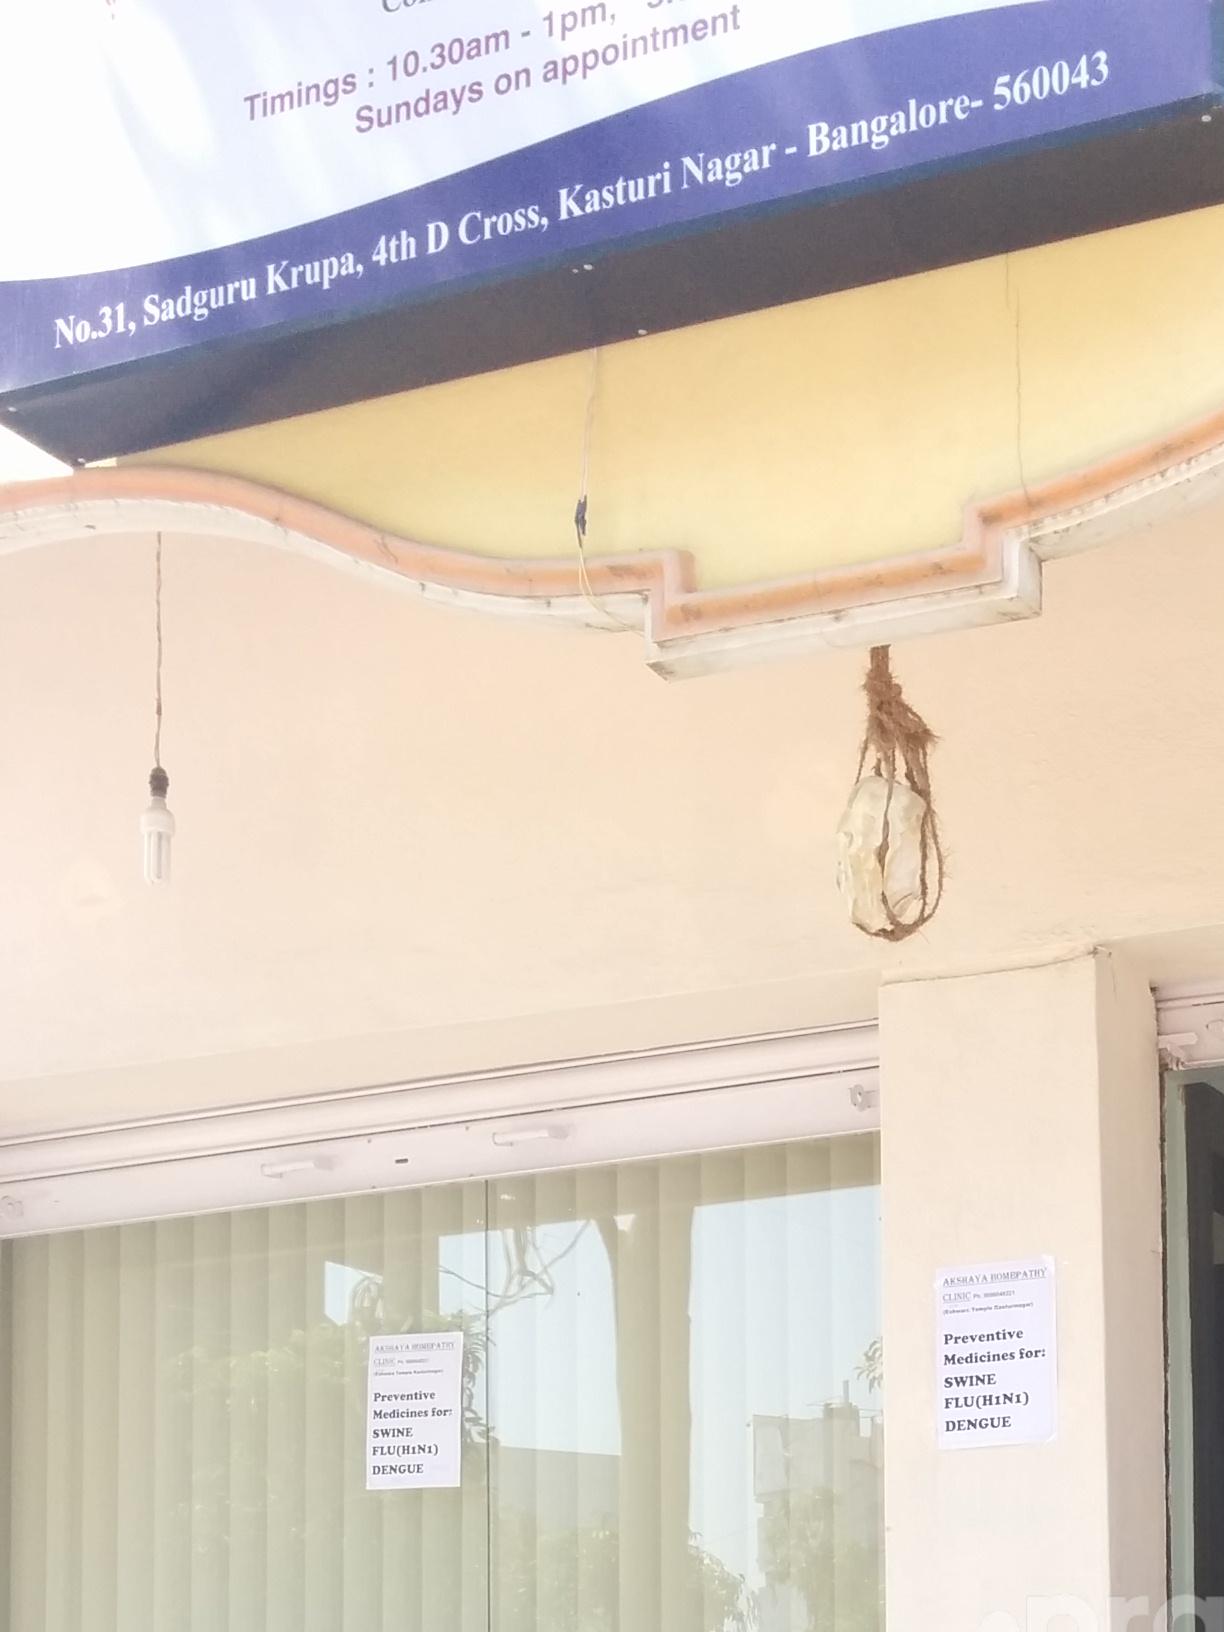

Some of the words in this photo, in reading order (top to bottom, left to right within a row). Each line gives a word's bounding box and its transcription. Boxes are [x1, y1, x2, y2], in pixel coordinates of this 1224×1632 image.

[243, 72, 358, 121] Timings
[386, 28, 511, 81] 10.30am
[542, 3, 617, 41] 1pm,
[355, 79, 484, 134] Sundays
[494, 66, 532, 96] on
[542, 4, 741, 85] appointment
[54, 302, 136, 349] No.31,
[143, 276, 257, 322] Sadguru
[266, 251, 364, 295] Krupa,
[371, 230, 417, 266] 4th
[426, 220, 449, 255] D
[458, 204, 549, 245] Cross,
[558, 161, 672, 221] Kasturi
[680, 142, 777, 189] Nagar
[993, 50, 1110, 111] 560043
[943, 1273, 988, 1287] AKSHAYA
[943, 1291, 972, 1302] CLINIC
[943, 1328, 1024, 1345] Preventive
[943, 1350, 1015, 1366] Medicines
[1019, 1347, 1046, 1359] for:
[944, 1373, 996, 1388] SWINE
[373, 1390, 436, 1402] Preventive
[944, 1392, 1029, 1410] FLU(H1N1)
[372, 1408, 428, 1420] Medicines
[431, 1407, 453, 1417] for:
[945, 1416, 1011, 1432] DENGUE
[372, 1427, 413, 1439] SWINE
[372, 1444, 439, 1457] FLU(H1N1)
[372, 1464, 424, 1475] DENGUE
